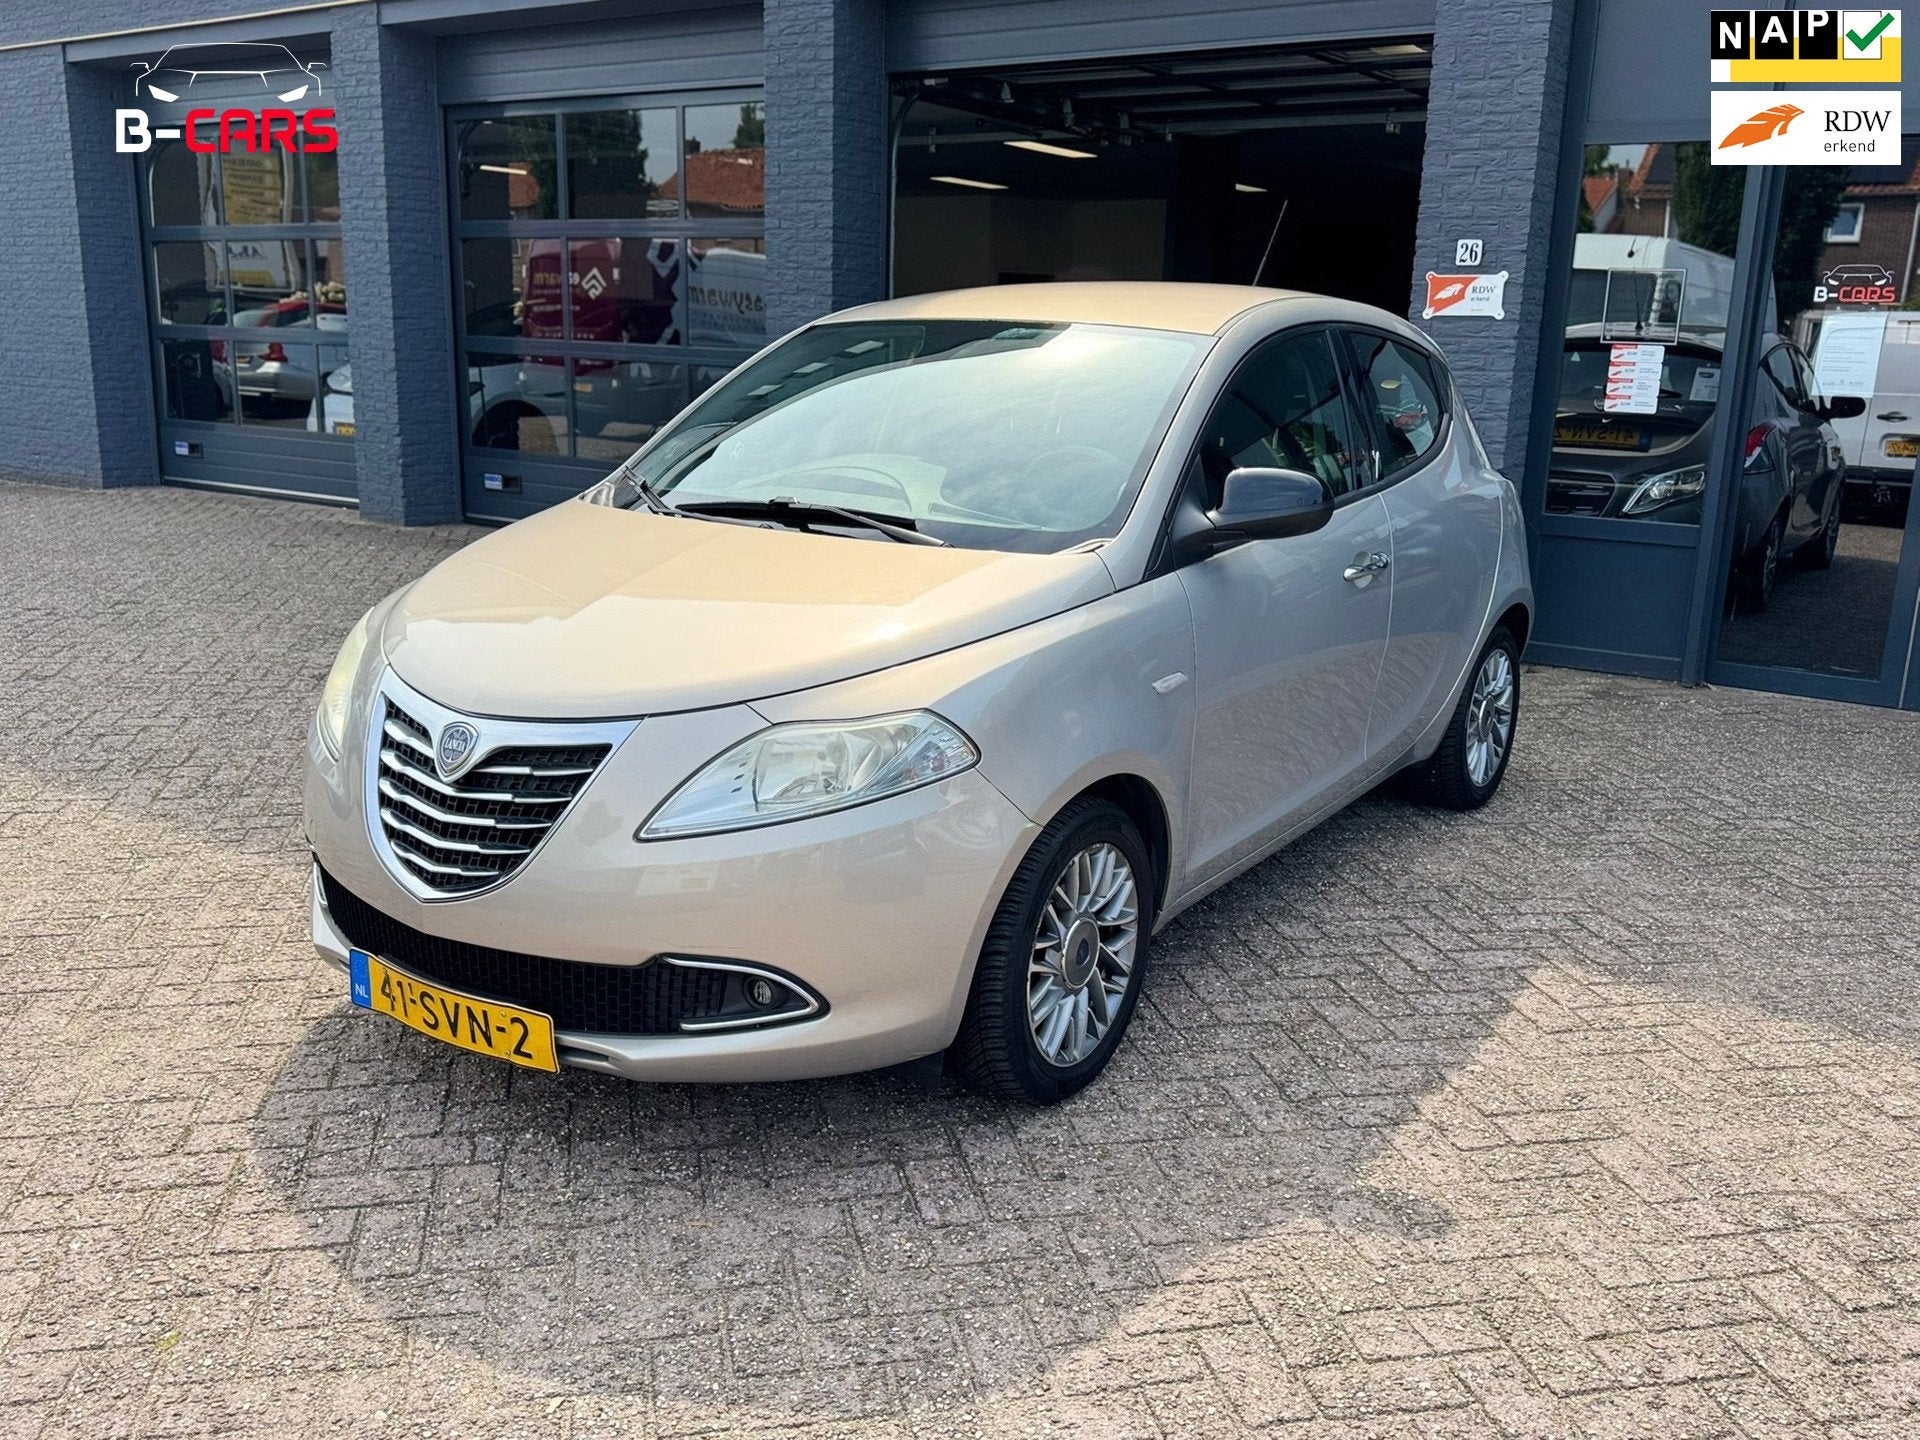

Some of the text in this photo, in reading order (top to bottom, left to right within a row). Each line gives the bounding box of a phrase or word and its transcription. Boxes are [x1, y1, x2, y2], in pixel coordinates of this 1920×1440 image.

[1459, 242, 1479, 263] 26
[1471, 285, 1495, 294] RDW
[1813, 286, 1896, 303] B-CARS
[355, 983, 369, 998] NL
[380, 970, 533, 1060] 41-SVN-2
